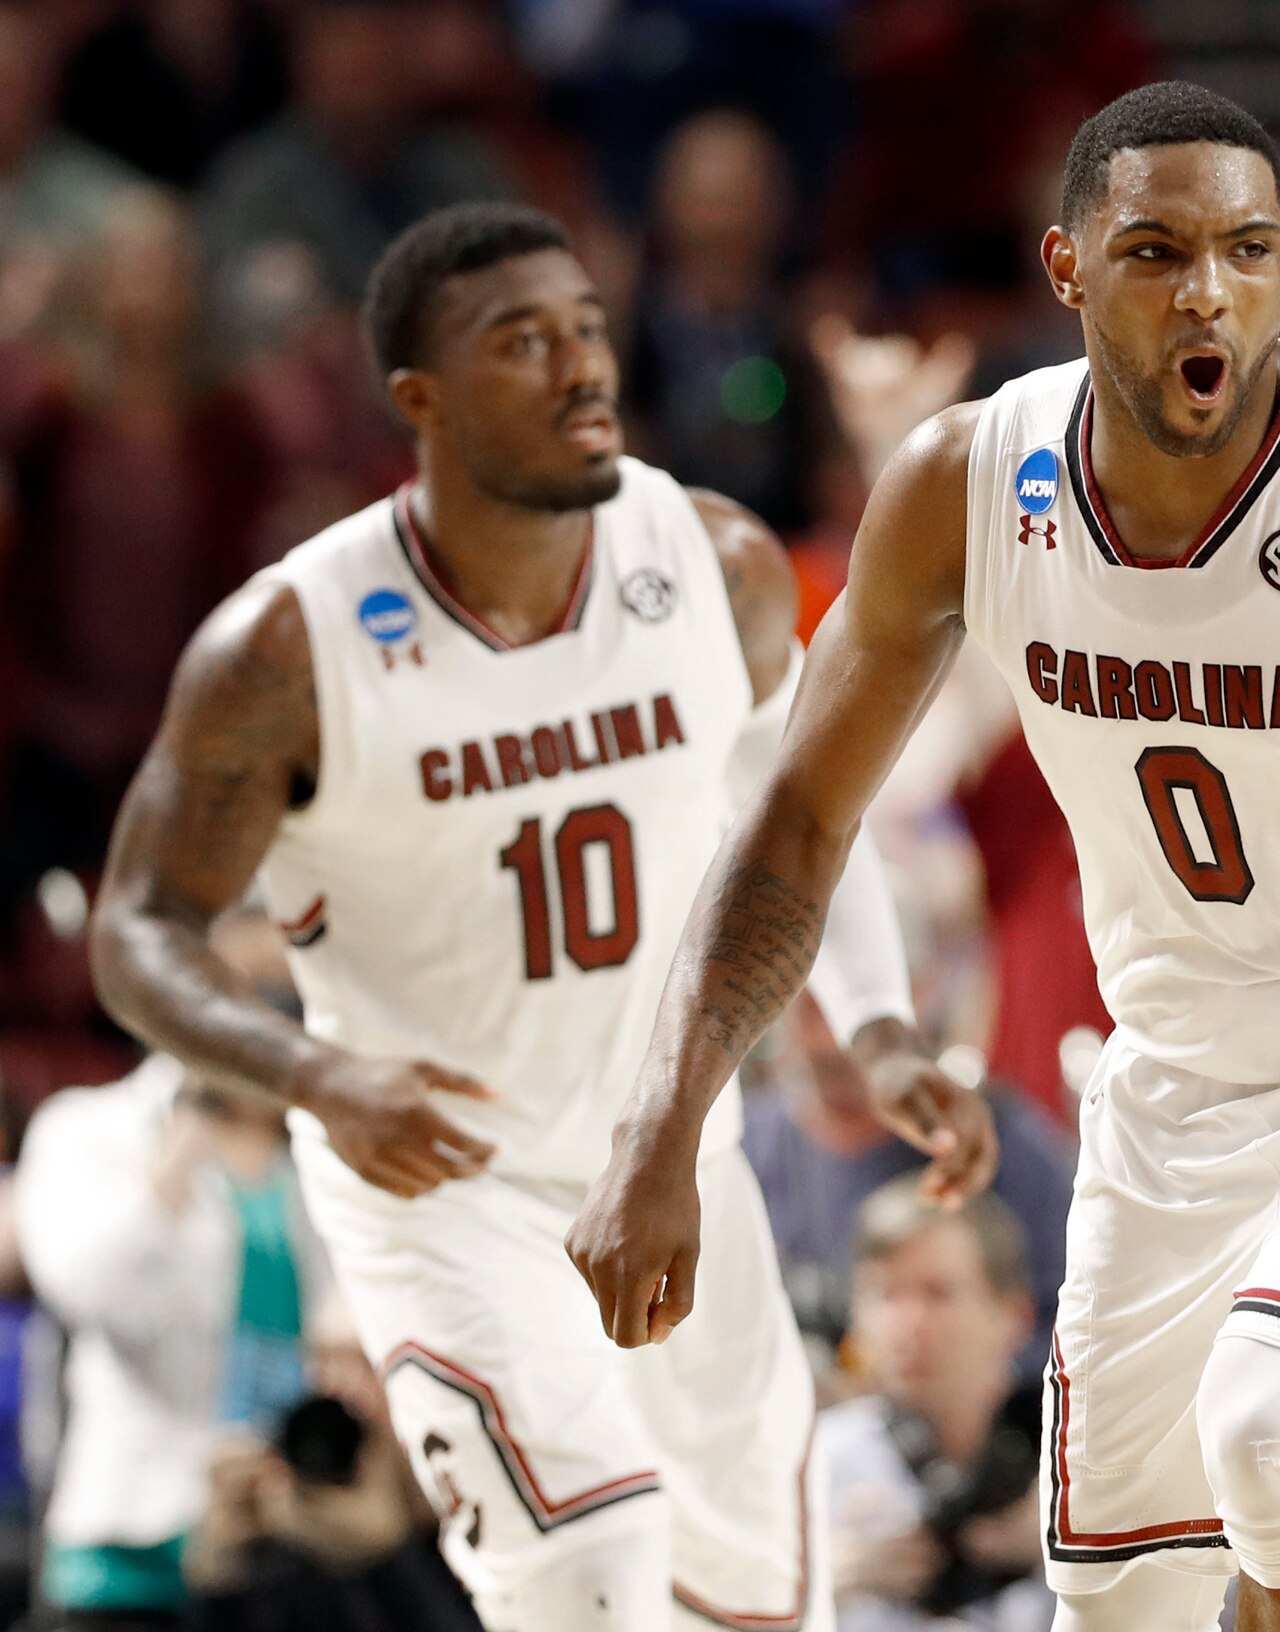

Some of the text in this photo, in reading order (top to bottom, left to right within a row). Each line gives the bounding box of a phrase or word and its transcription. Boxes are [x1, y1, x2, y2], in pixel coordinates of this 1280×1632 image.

[419, 694, 685, 803] CAROLINA
[1134, 745, 1255, 905] 0
[500, 801, 641, 980] 10
